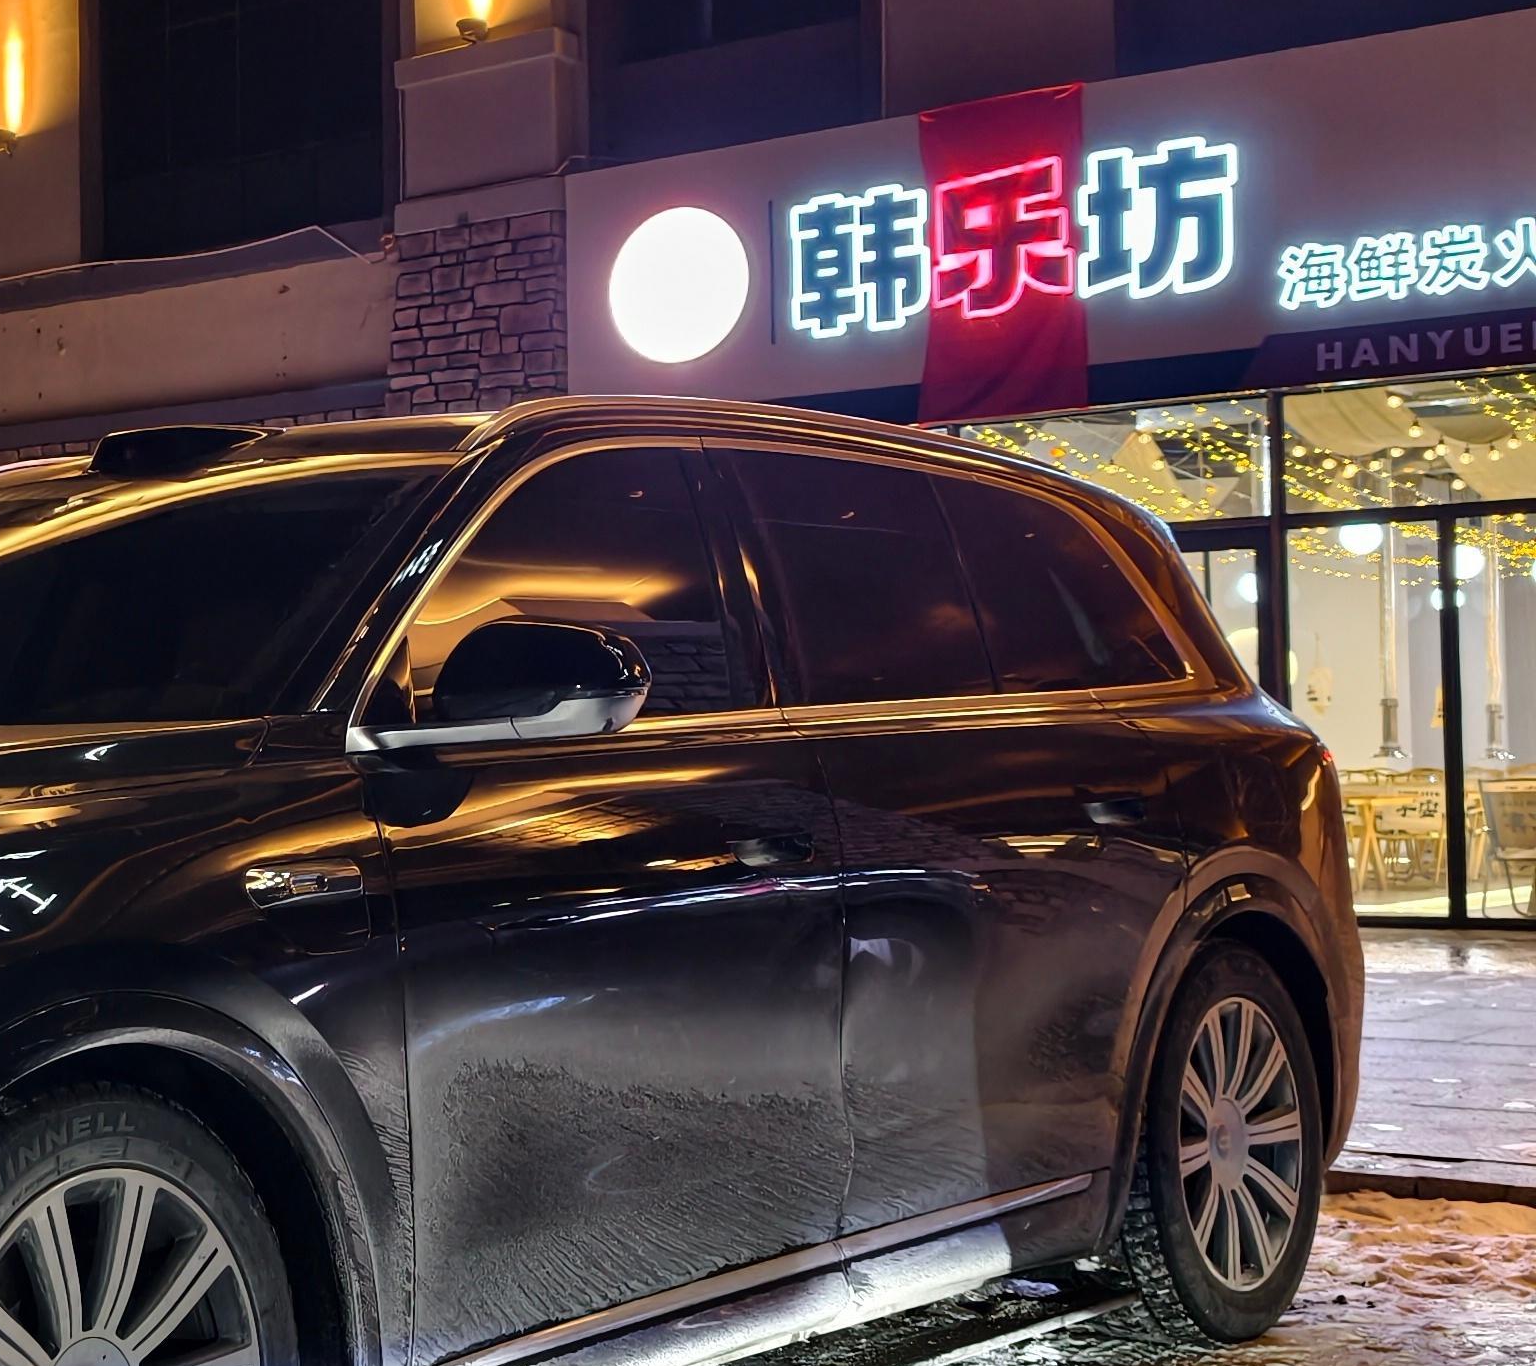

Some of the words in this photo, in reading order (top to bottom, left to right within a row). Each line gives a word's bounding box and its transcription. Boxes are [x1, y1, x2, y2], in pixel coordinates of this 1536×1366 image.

[790, 136, 1239, 339] 韩乐坊
[1316, 320, 1536, 372] HANYUE
